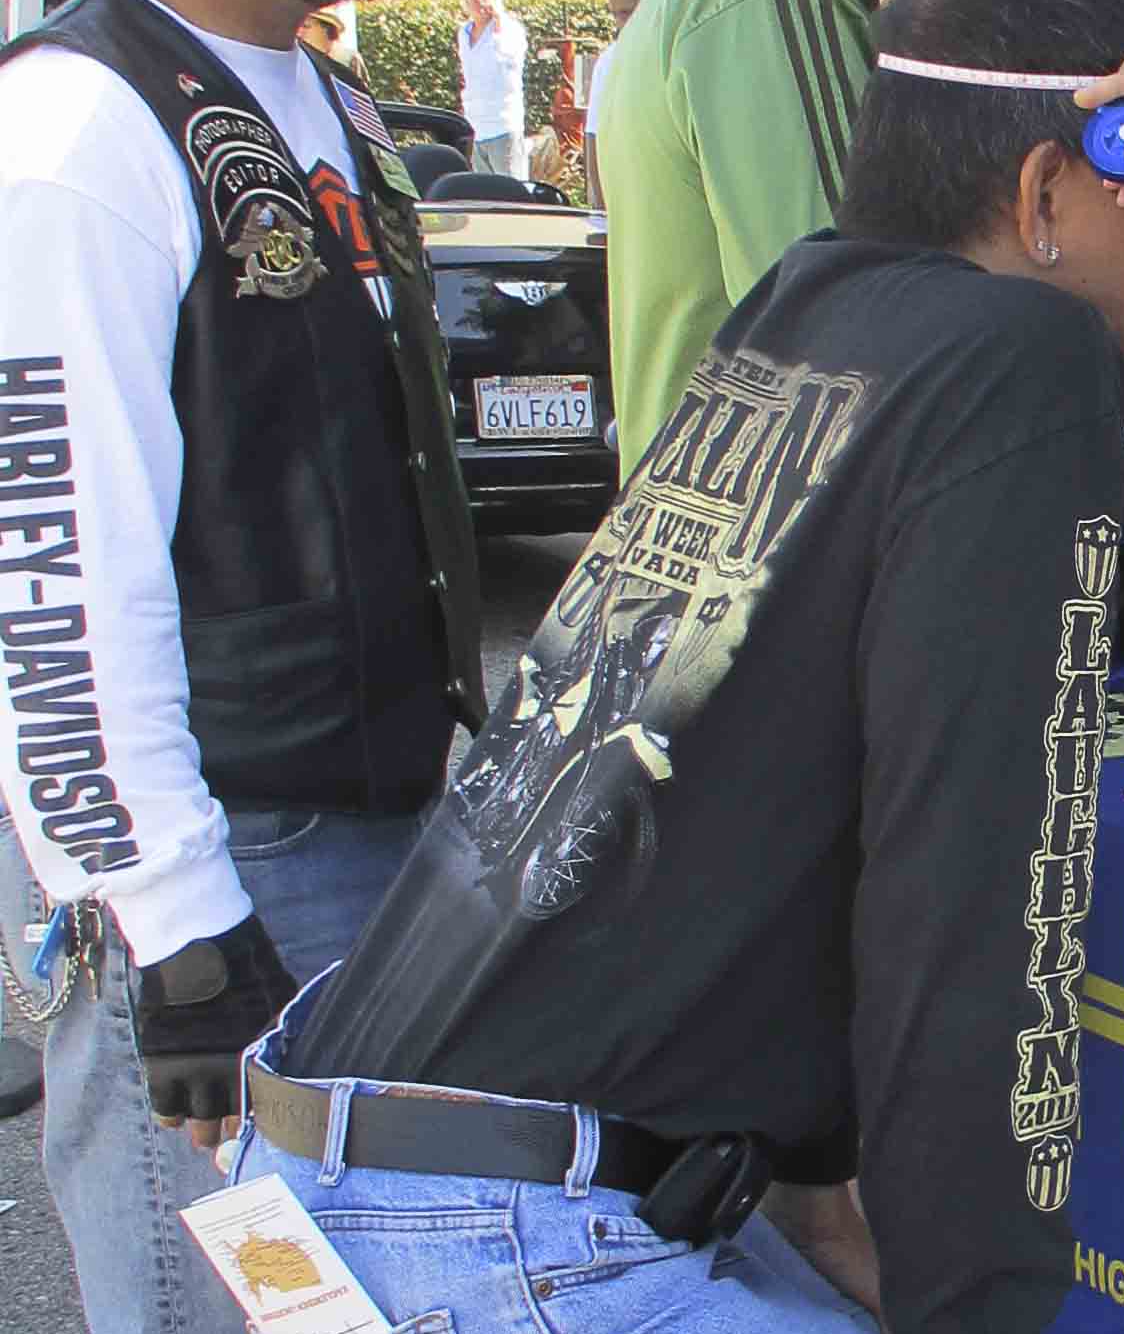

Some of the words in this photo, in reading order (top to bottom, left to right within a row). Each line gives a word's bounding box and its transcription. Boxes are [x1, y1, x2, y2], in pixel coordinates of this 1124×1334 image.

[223, 163, 281, 194] EDITOR
[487, 398, 587, 428] 6VLF619
[654, 509, 720, 562] WEEK
[631, 546, 701, 586] VADA
[1014, 1094, 1077, 1135] 2011
